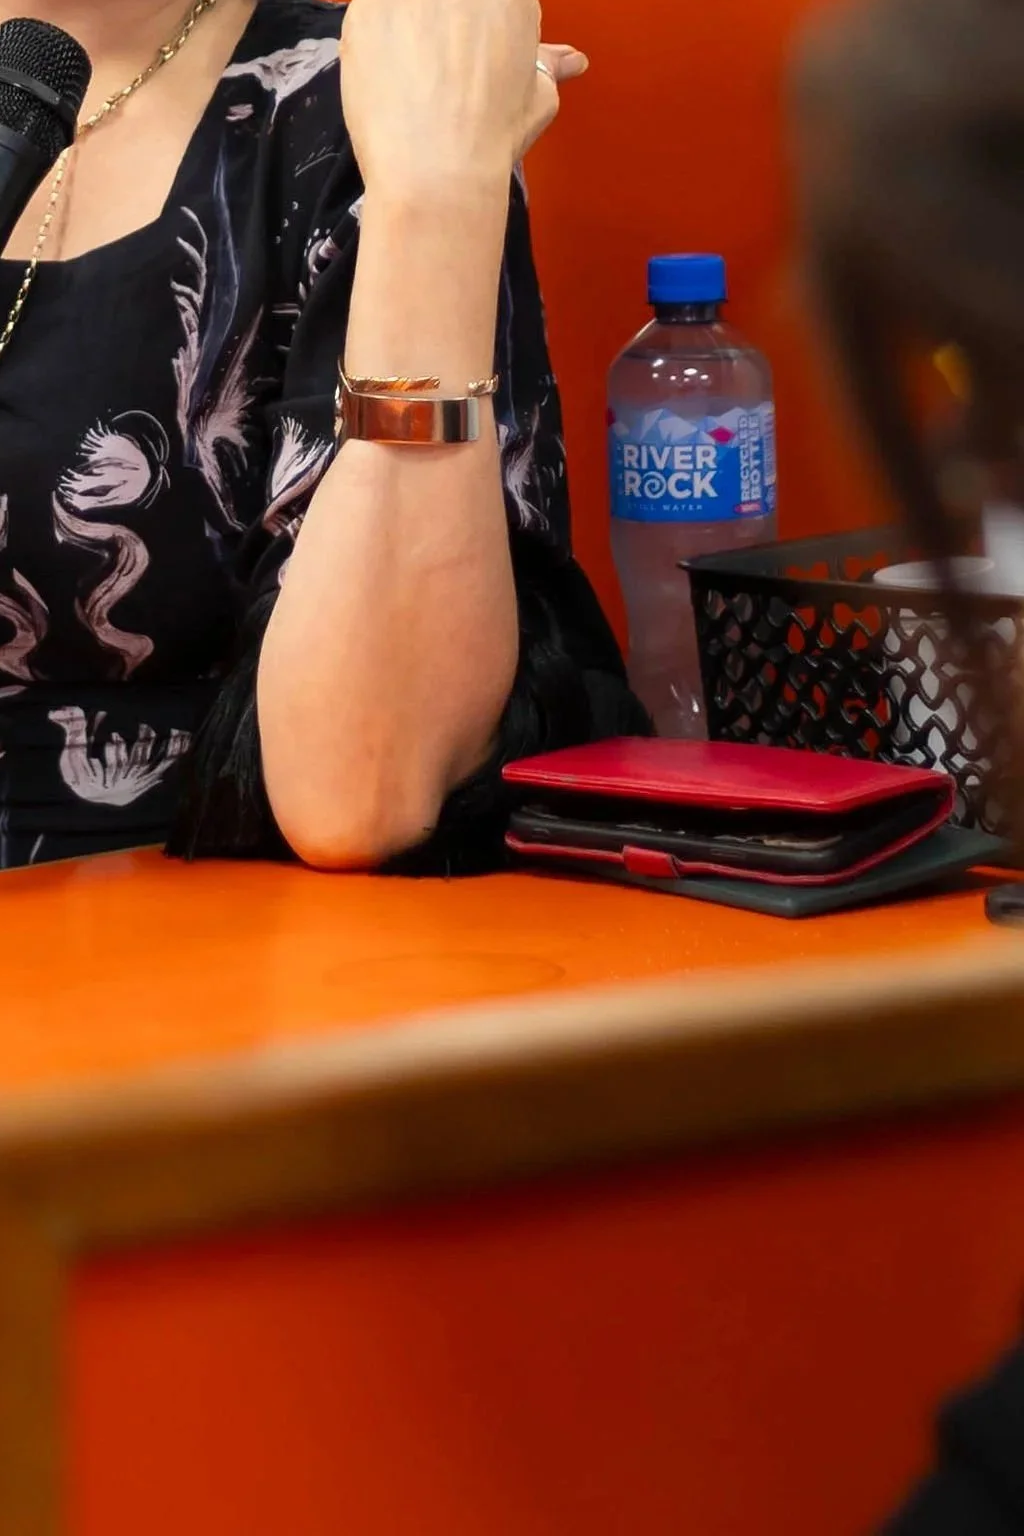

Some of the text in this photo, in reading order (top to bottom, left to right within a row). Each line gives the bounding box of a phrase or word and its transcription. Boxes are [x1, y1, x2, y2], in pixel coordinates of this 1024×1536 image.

[623, 444, 718, 470] RIVER
[739, 415, 750, 501] RECYCLED
[749, 413, 762, 500] BOTTLE
[624, 471, 718, 499] ROCK
[662, 503, 704, 511] WATER
